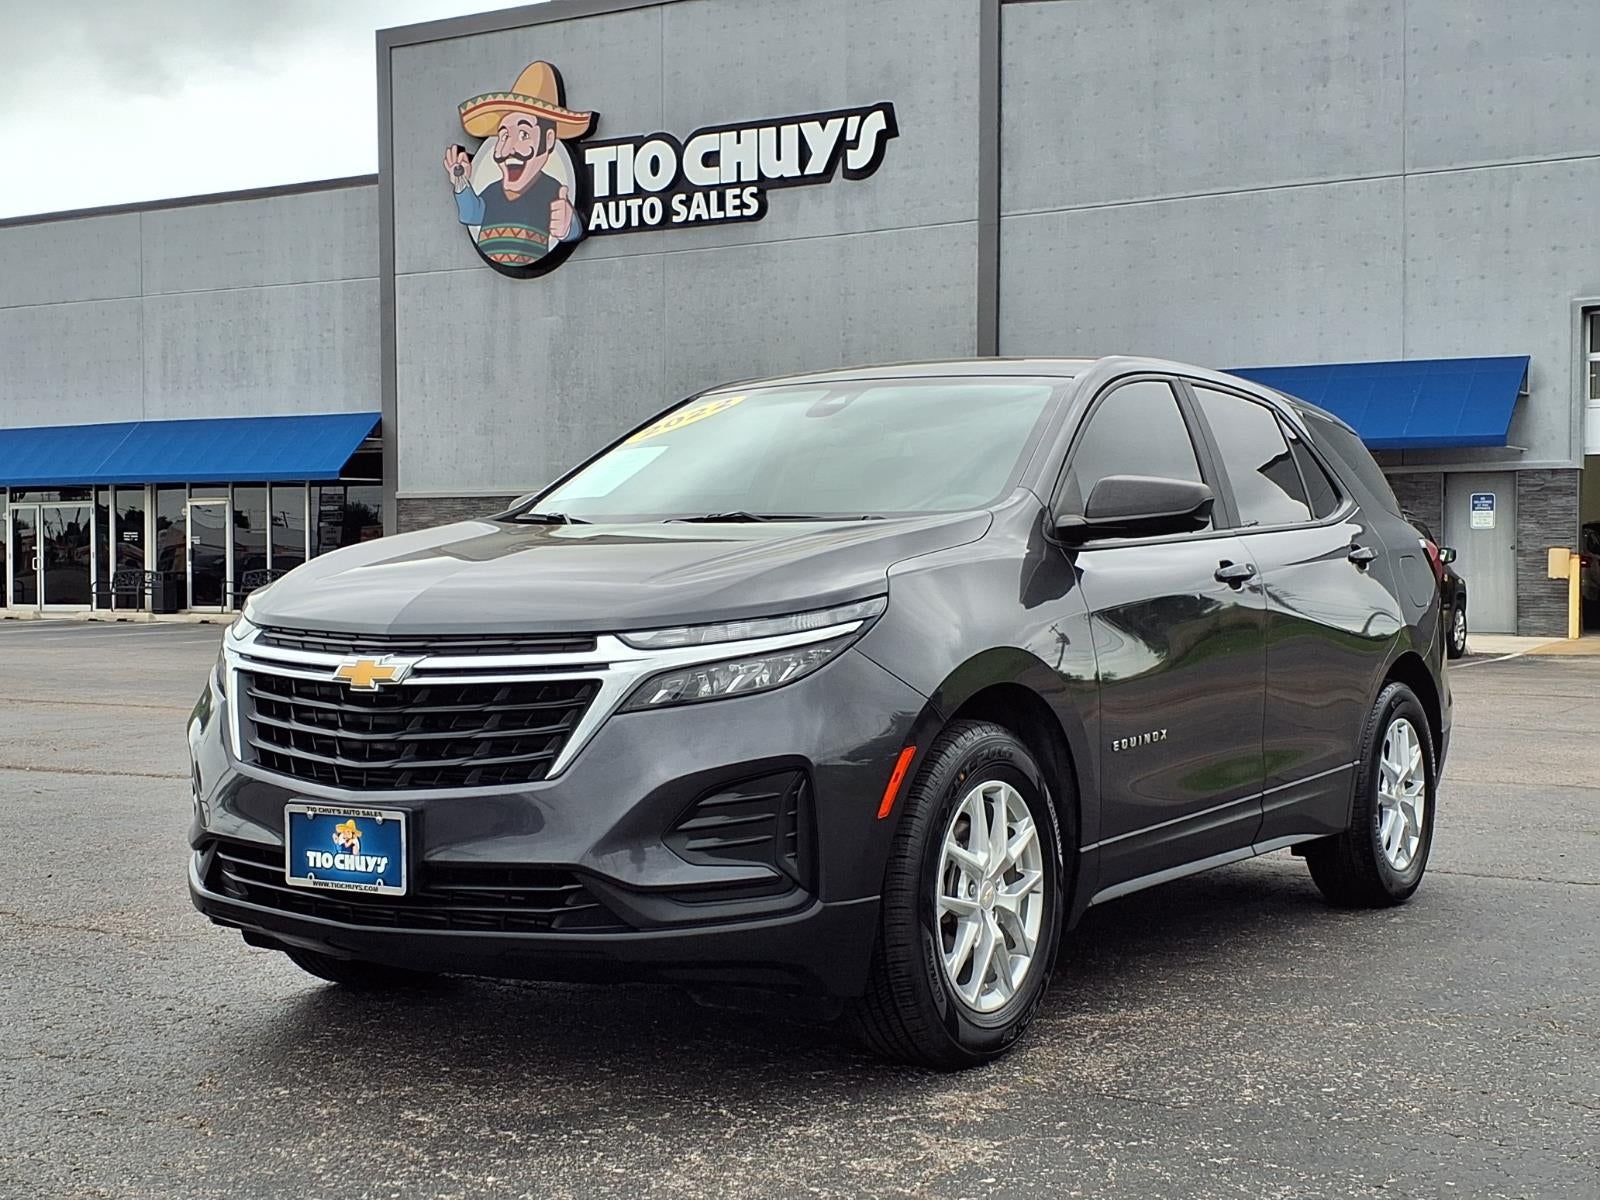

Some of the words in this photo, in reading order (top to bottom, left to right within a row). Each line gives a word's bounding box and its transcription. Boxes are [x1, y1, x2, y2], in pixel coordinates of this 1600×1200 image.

[585, 139, 677, 197] TIO
[682, 110, 887, 186] CHUY'S
[588, 197, 663, 231] AUTO
[671, 186, 759, 223] SALES
[1112, 728, 1167, 752] EQUINOX
[318, 807, 341, 815] CHUY'S
[343, 808, 360, 816] AUTO
[361, 810, 383, 818] SALES
[312, 880, 379, 892] WWW.TIOCHUYS.COM
